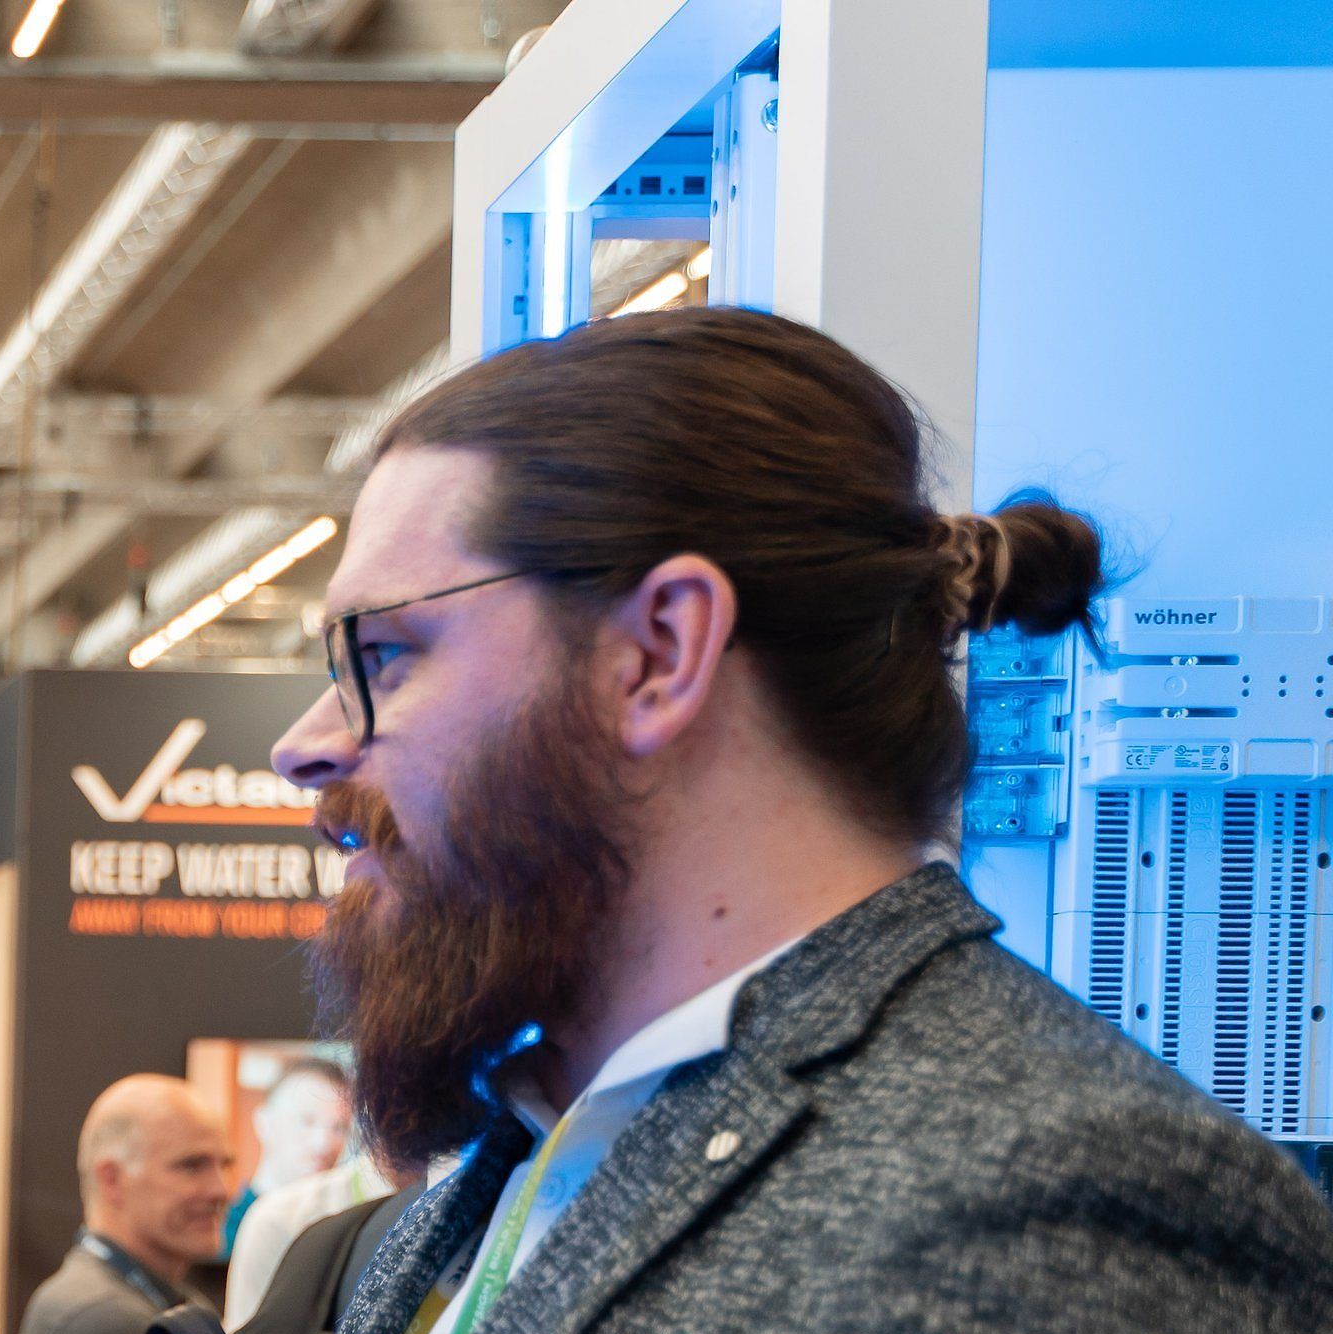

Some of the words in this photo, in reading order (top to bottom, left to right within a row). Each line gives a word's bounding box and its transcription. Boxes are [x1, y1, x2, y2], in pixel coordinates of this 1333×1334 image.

[1134, 608, 1217, 625] wöhner
[70, 841, 175, 895] KEEP
[176, 843, 312, 898] WATER
